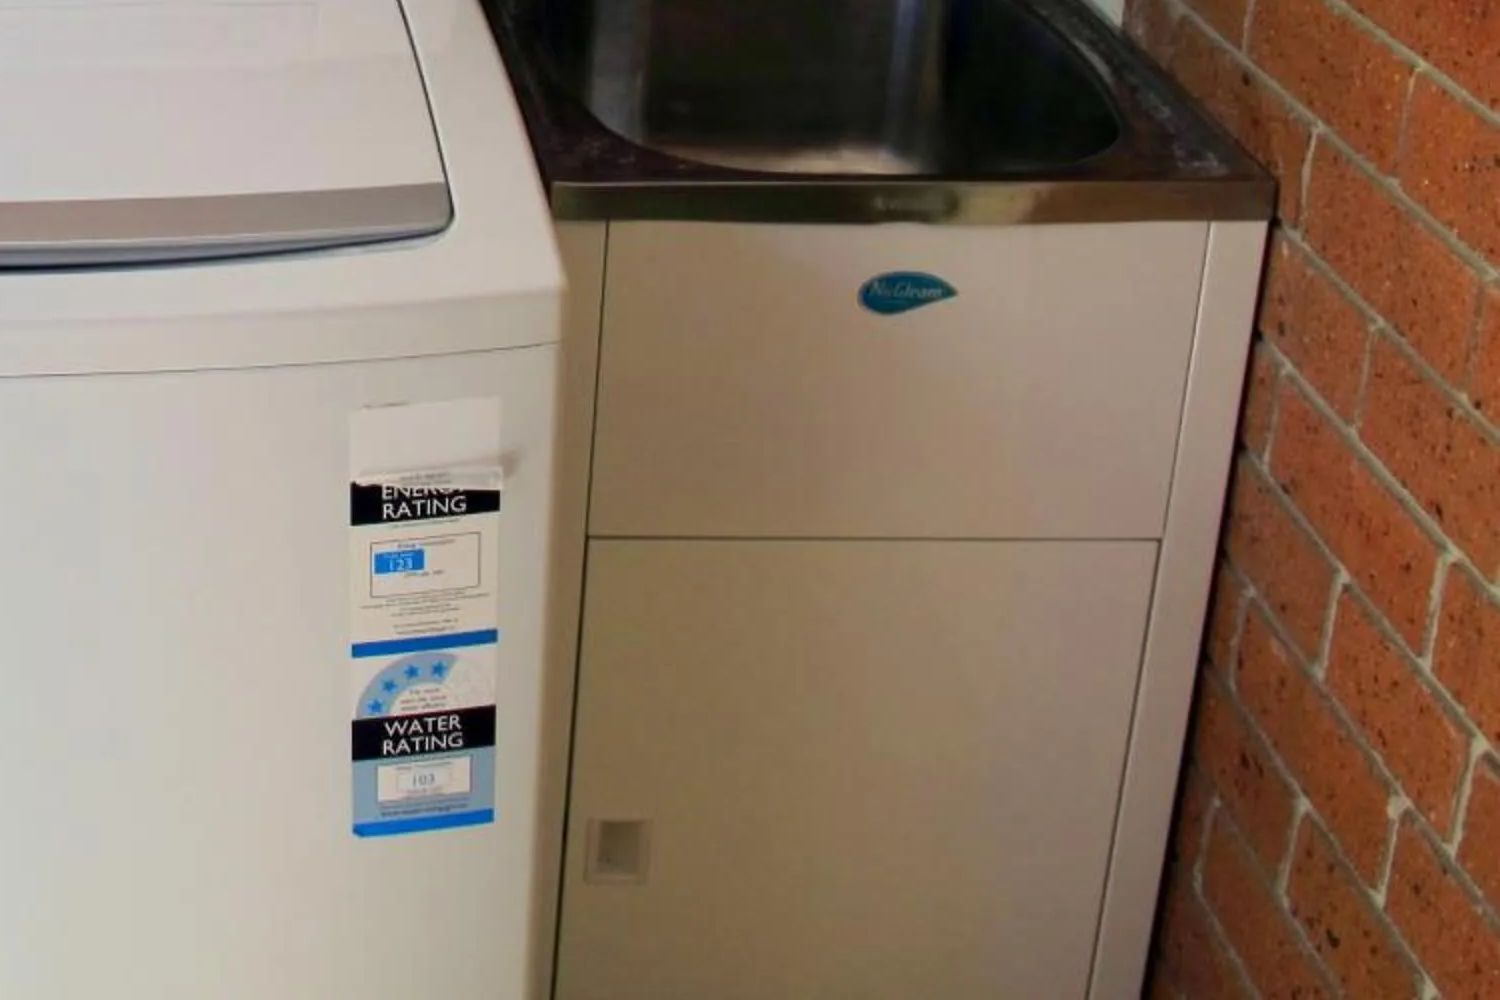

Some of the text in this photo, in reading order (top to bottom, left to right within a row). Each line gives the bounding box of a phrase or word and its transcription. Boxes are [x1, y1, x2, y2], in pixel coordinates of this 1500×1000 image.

[380, 484, 465, 500] ENER
[382, 494, 467, 520] RATING
[388, 556, 415, 572] 123
[384, 715, 463, 738] WATER
[382, 731, 465, 756] RATING
